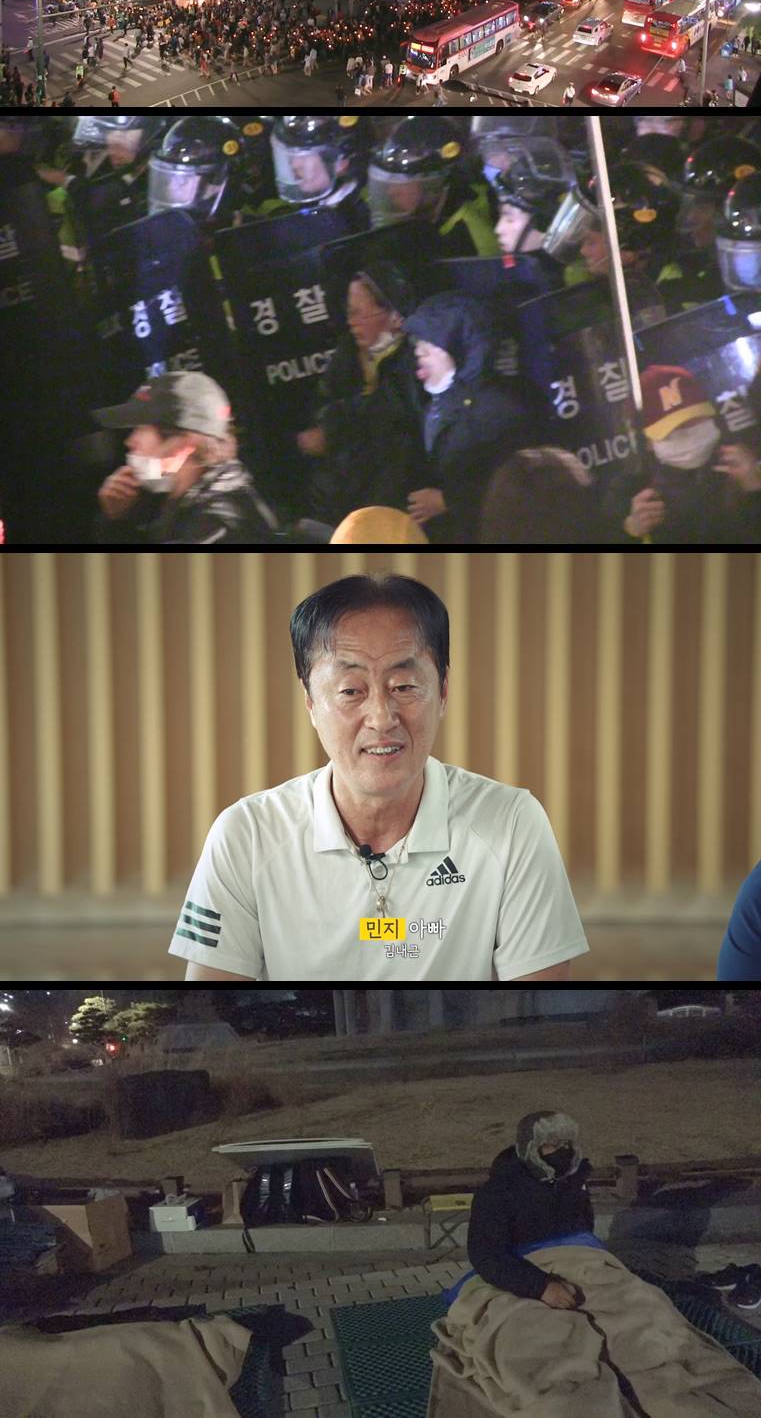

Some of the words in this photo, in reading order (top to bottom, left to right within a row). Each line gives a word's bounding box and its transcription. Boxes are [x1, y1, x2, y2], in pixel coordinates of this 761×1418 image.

[129, 287, 188, 339] 경찰
[251, 284, 330, 336] 경찰
[550, 358, 630, 420] 경찰
[577, 430, 638, 470] OLIC
[425, 874, 467, 887] adidas
